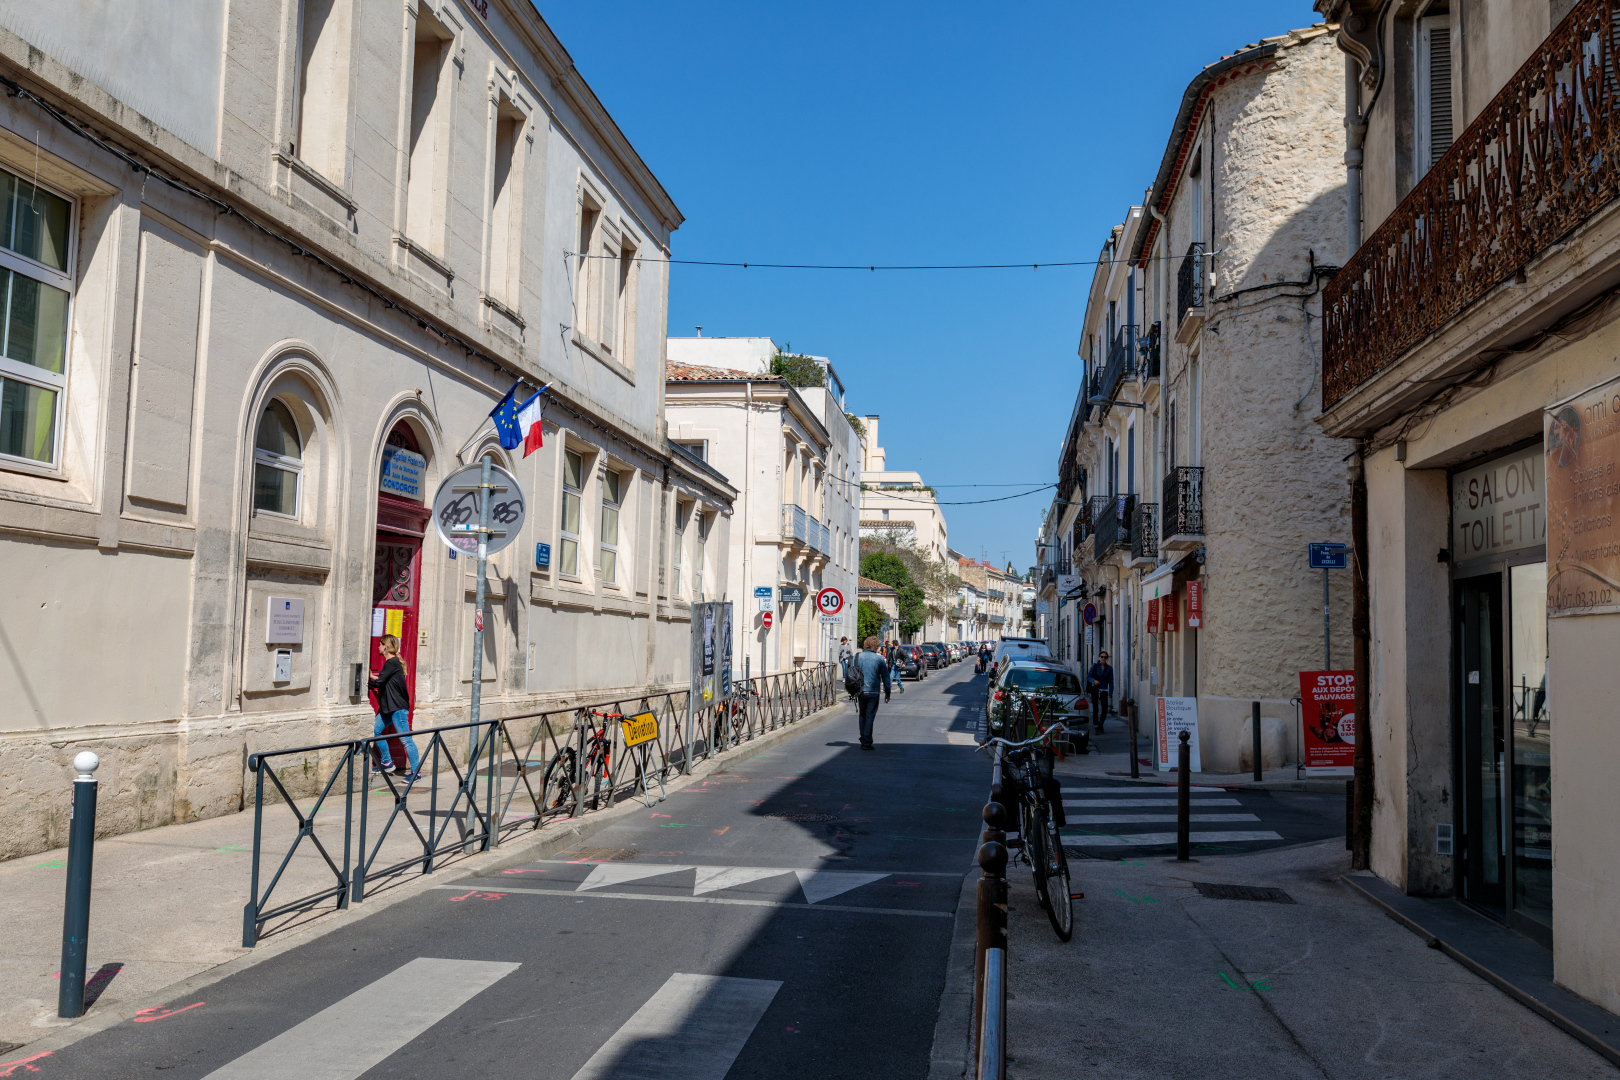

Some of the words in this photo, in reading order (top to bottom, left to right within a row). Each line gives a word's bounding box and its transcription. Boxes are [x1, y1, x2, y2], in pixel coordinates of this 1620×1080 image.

[471, 0, 488, 20] LE
[1584, 393, 1607, 426] ami
[1573, 466, 1603, 485] Coupes
[1606, 461, 1615, 475] et
[383, 478, 418, 494] CONDORCET
[1468, 456, 1535, 511] SALON
[822, 595, 839, 607] 30
[1189, 582, 1198, 610] maria,
[1317, 674, 1355, 686] STOP
[1313, 693, 1355, 701] SAUVAGES
